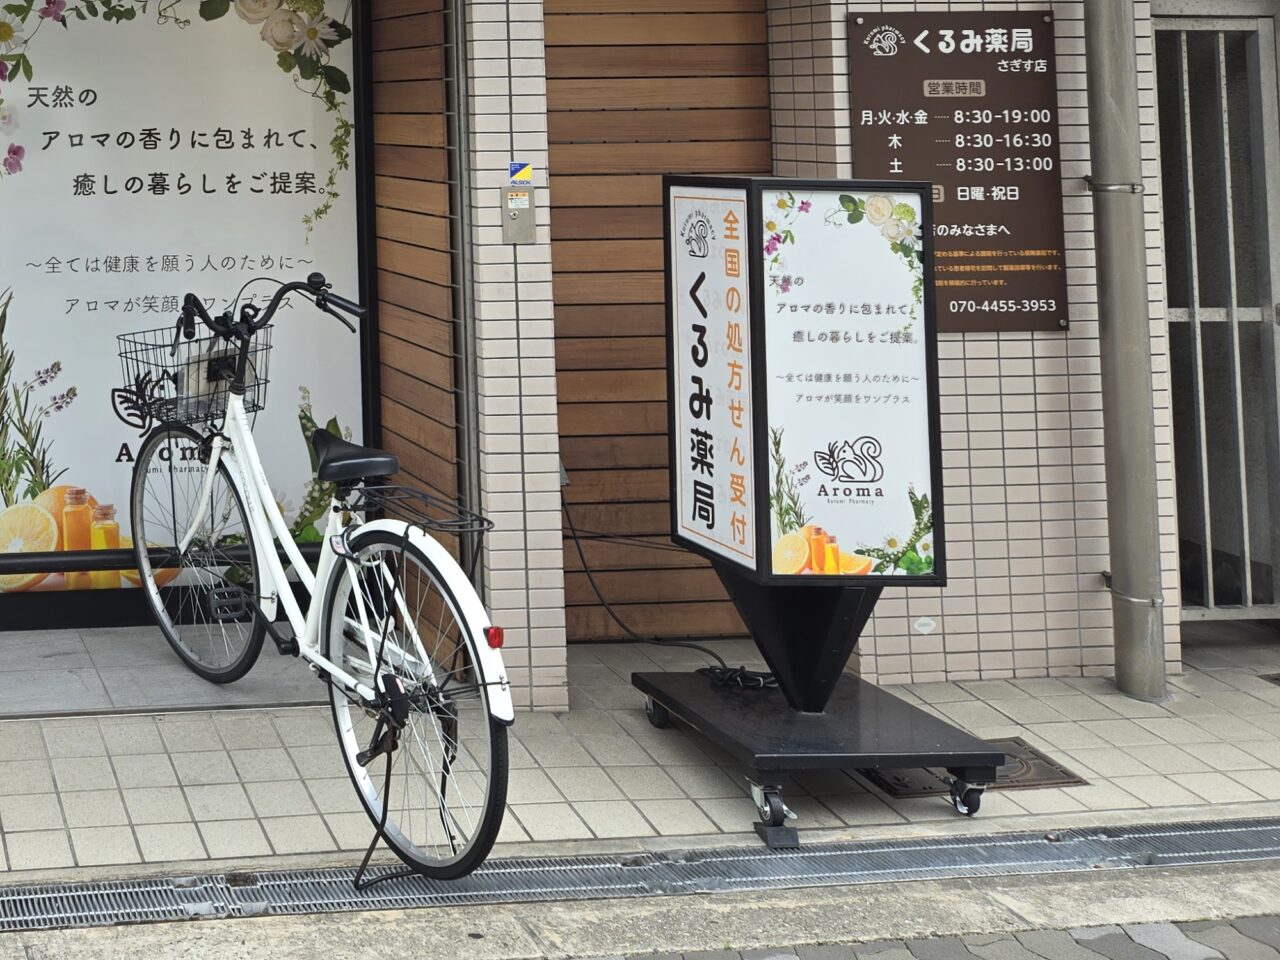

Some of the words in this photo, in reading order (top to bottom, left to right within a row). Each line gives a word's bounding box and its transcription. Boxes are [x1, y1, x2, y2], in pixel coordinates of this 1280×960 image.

[913, 28, 1033, 53] くるみ薬局
[997, 59, 1047, 73] さぎす店
[26, 85, 98, 108] 天然の
[927, 81, 983, 96] 営業時間
[40, 127, 319, 152] アロマの香りに包まれて、
[888, 133, 903, 149] 木
[889, 158, 904, 174] 土
[72, 171, 326, 196] 癒しの暮らしをご提案。
[933, 224, 1011, 237] のみなさまへ
[64, 292, 295, 315] アロマが笑顔ワンプラス
[949, 299, 1057, 313] 070-4455-3953
[722, 209, 748, 547] 全国の処方せん受付
[688, 271, 715, 530] くるみ薬局
[817, 483, 884, 497] Aroma
